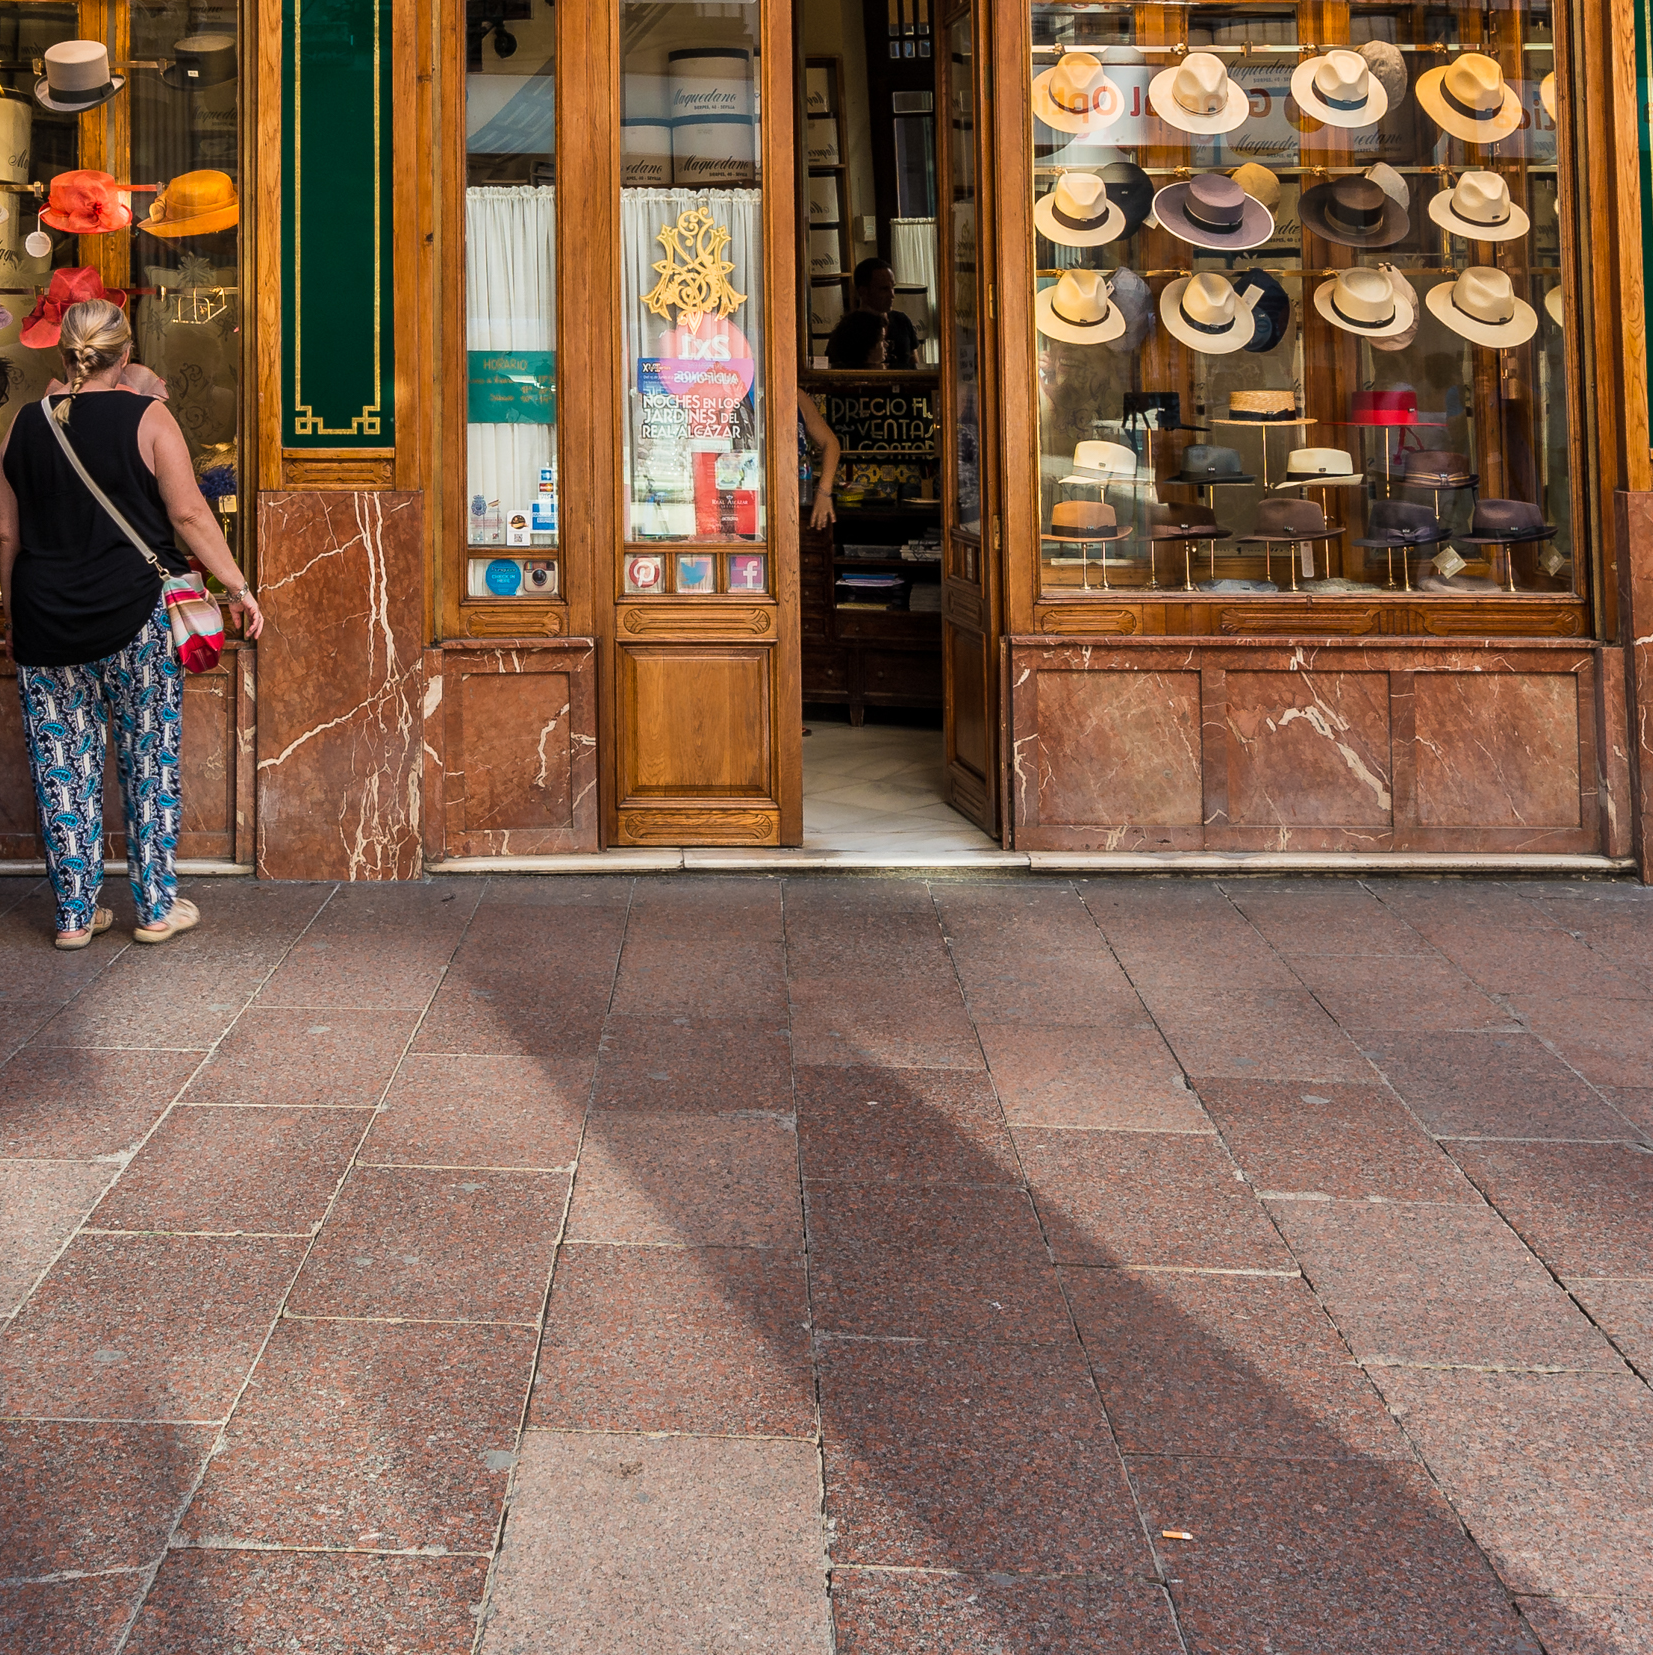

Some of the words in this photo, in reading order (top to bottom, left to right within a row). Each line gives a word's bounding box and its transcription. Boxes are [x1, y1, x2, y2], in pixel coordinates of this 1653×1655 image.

[483, 358, 528, 371] HORARIO
[642, 394, 700, 409] NOCHES
[703, 397, 717, 409] EN
[718, 397, 741, 410] LOS
[643, 408, 717, 424] JARDINES
[720, 412, 740, 424] DEL
[642, 424, 675, 439] REAL
